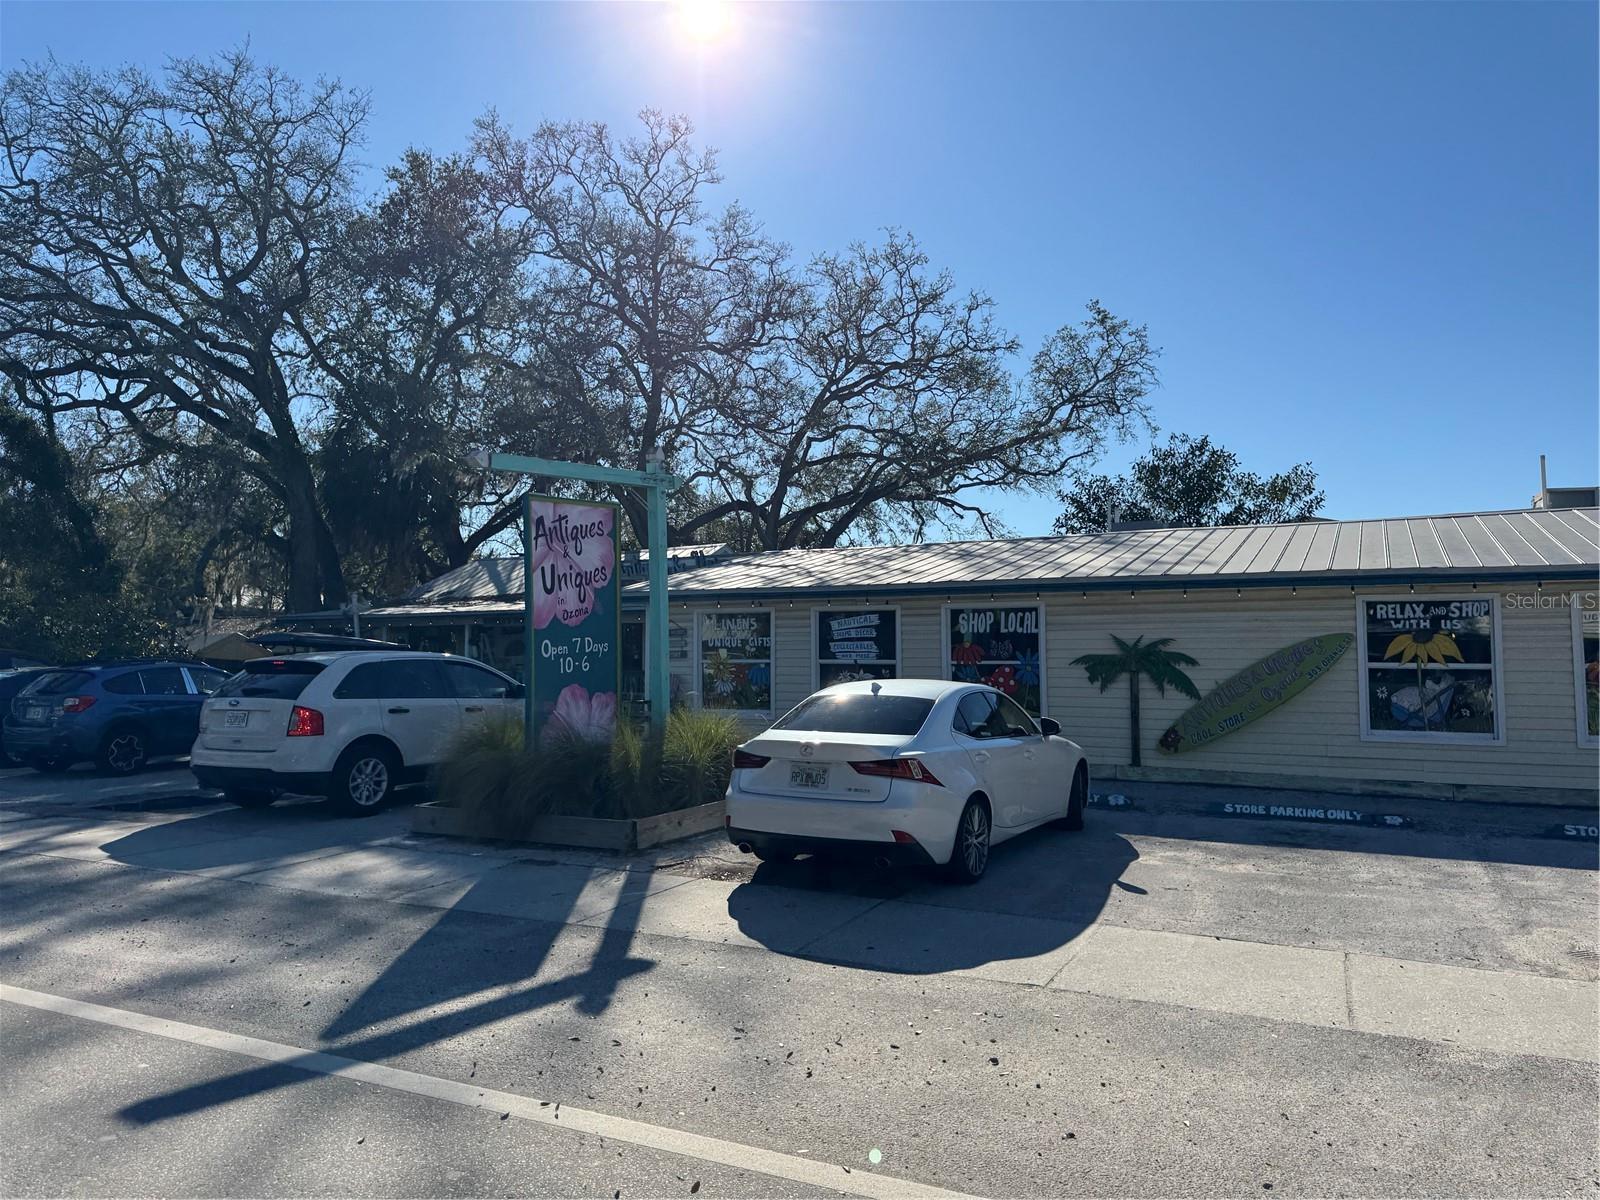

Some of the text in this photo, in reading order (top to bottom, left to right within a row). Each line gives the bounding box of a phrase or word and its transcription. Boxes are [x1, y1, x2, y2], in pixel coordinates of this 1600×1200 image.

[533, 514, 605, 557] Antiques
[562, 545, 572, 560] &
[540, 565, 608, 604] Uniques
[556, 597, 565, 606] in
[1376, 601, 1490, 620] RELAX AND SHOP
[562, 607, 589, 621] Ozona
[958, 610, 1040, 634] SHOP LOCAL
[1390, 619, 1463, 630] WITH US
[541, 637, 609, 660] Open 7 Days
[708, 636, 772, 648] UNIQUE GIFTS
[1217, 711, 1247, 733] STORE
[1224, 802, 1363, 821] STORE PARKING ONLY
